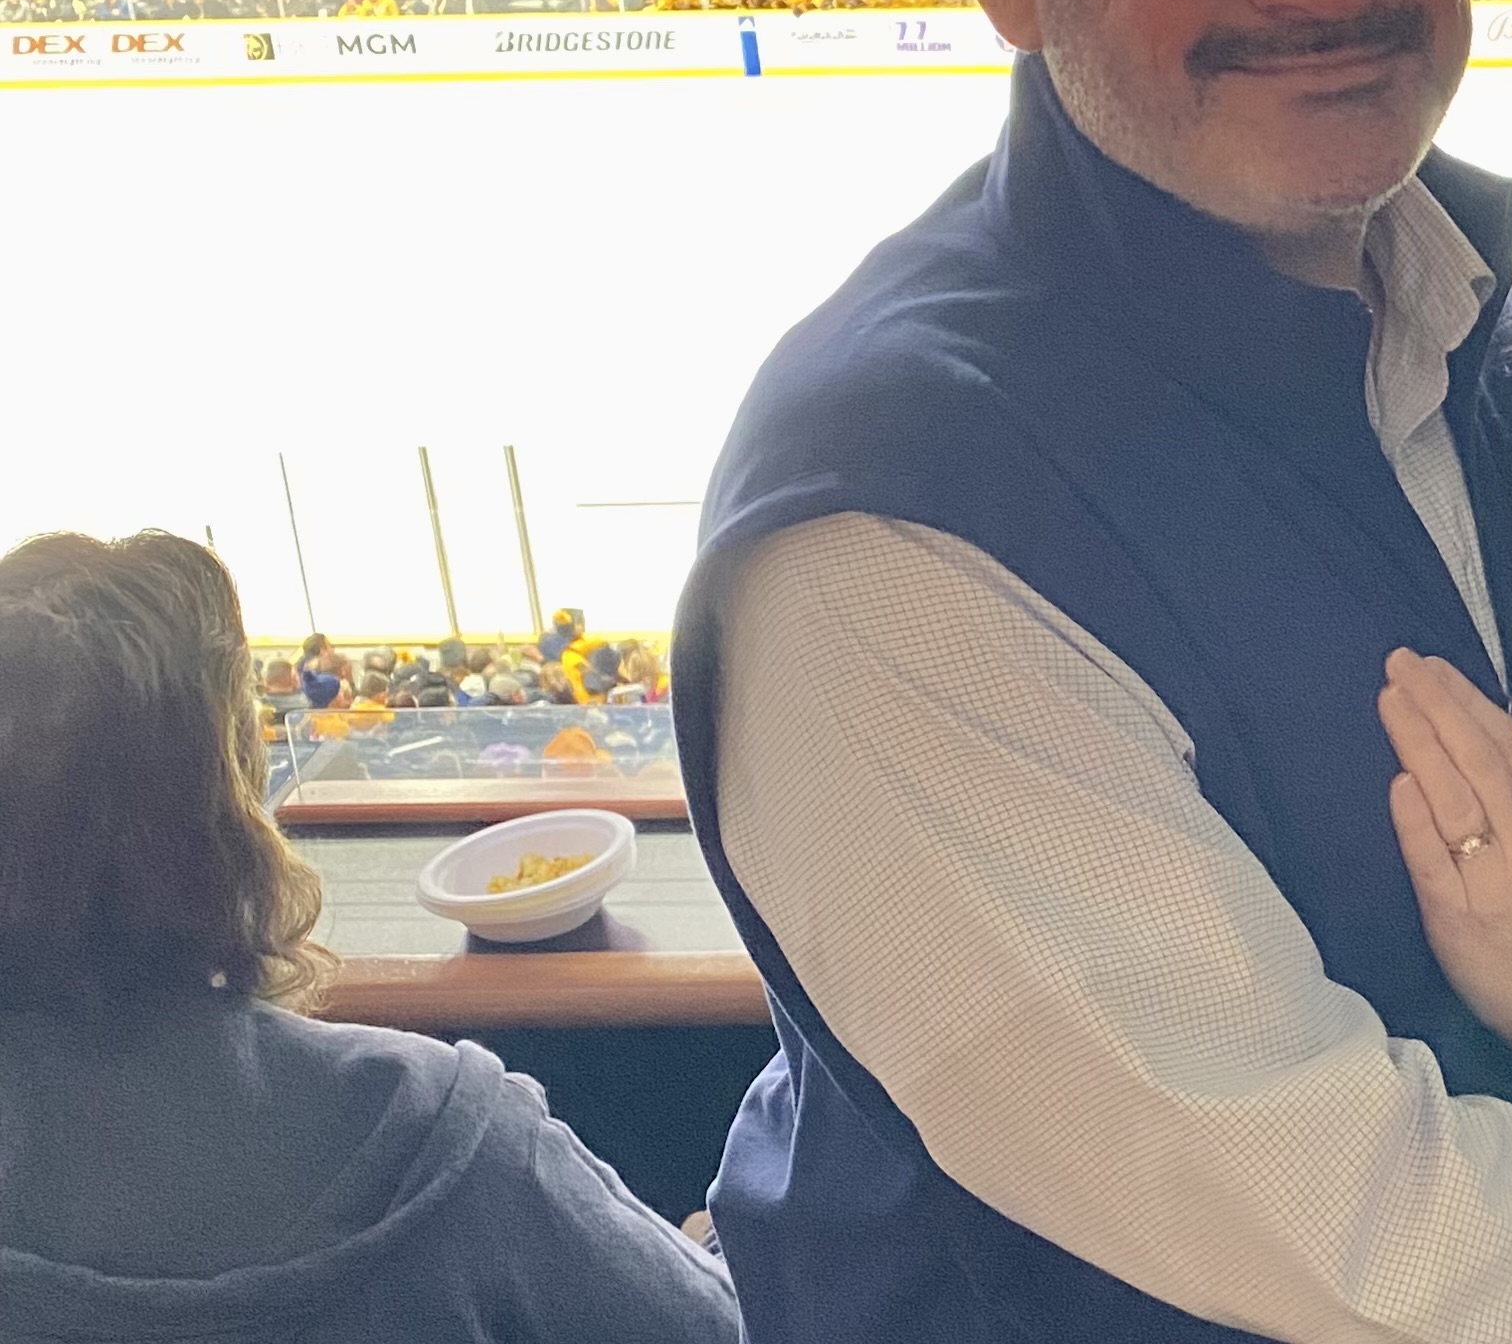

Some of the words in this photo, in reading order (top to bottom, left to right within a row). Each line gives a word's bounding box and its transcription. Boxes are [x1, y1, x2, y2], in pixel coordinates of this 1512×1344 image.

[12, 34, 87, 55] DEX
[111, 33, 186, 53] DEX
[336, 33, 417, 55] MGM
[495, 31, 676, 53] BRIDGESTONE
